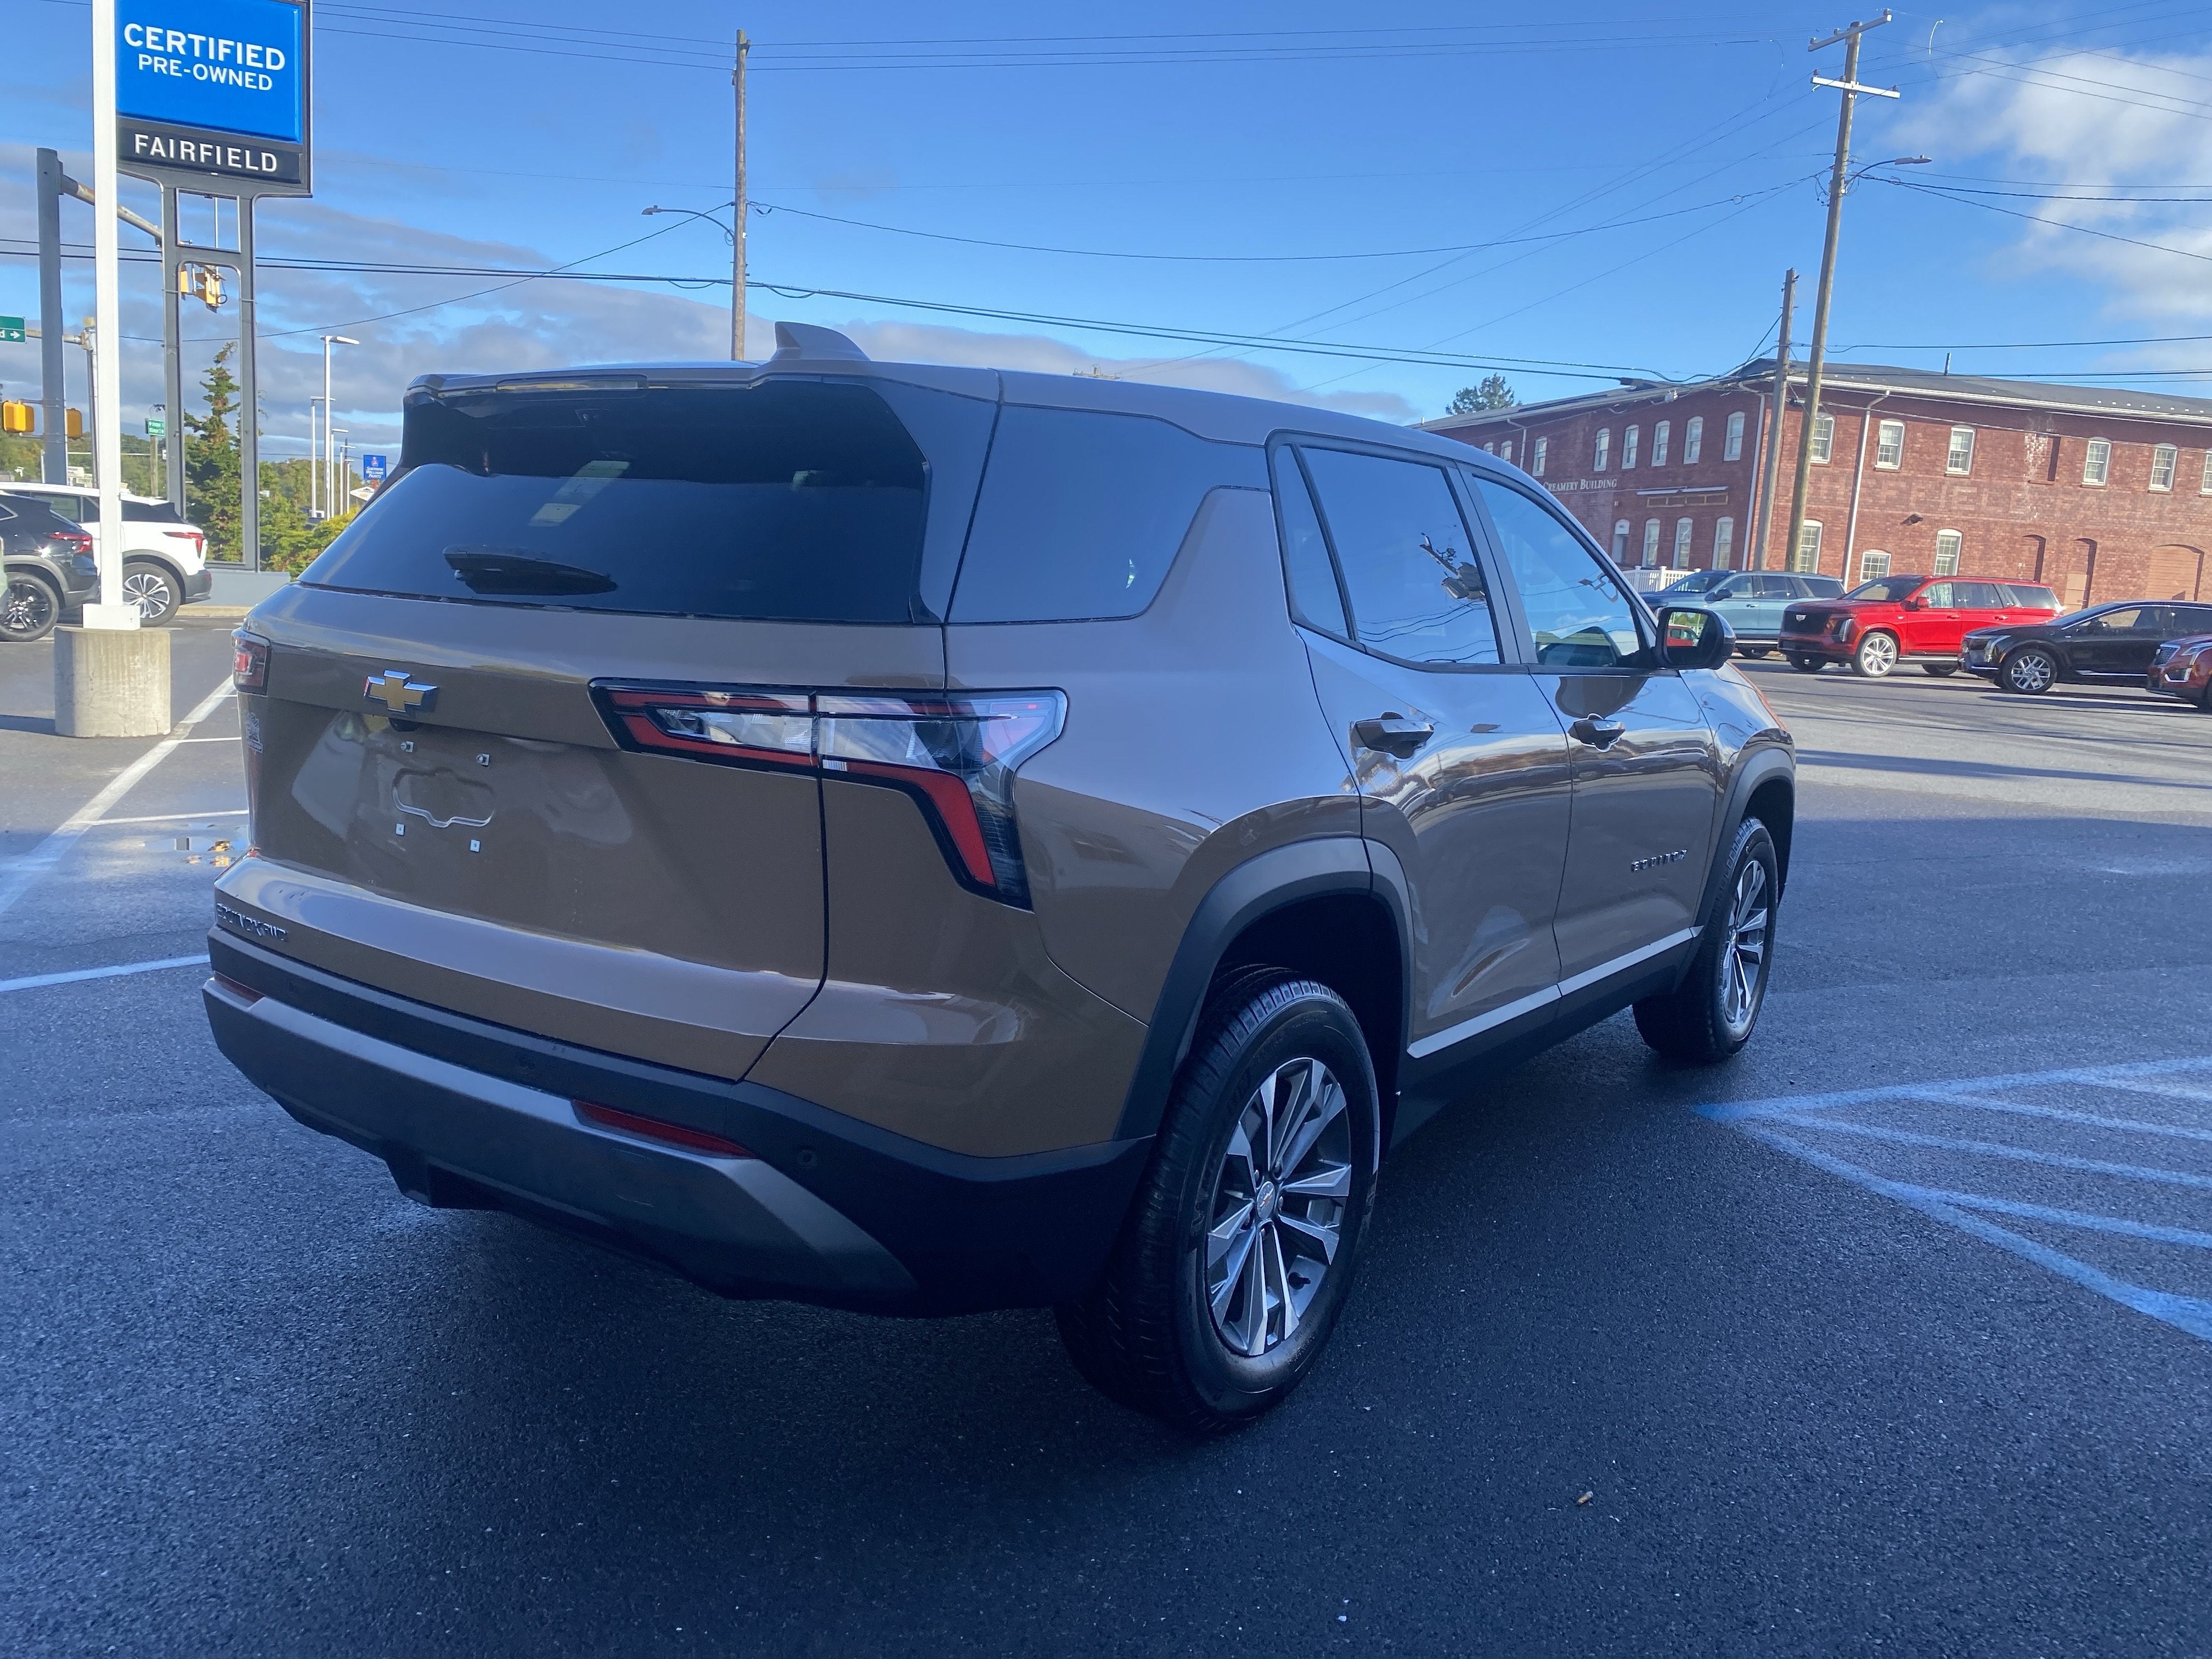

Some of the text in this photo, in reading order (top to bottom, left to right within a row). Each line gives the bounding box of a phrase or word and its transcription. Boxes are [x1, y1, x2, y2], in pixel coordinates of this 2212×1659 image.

[124, 24, 285, 71] CERTIFIED
[138, 53, 273, 91] PRE-OWNED
[134, 134, 278, 173] FAIRFIELD
[1580, 479, 1617, 490] BUILDING
[216, 902, 264, 936] ENOX
